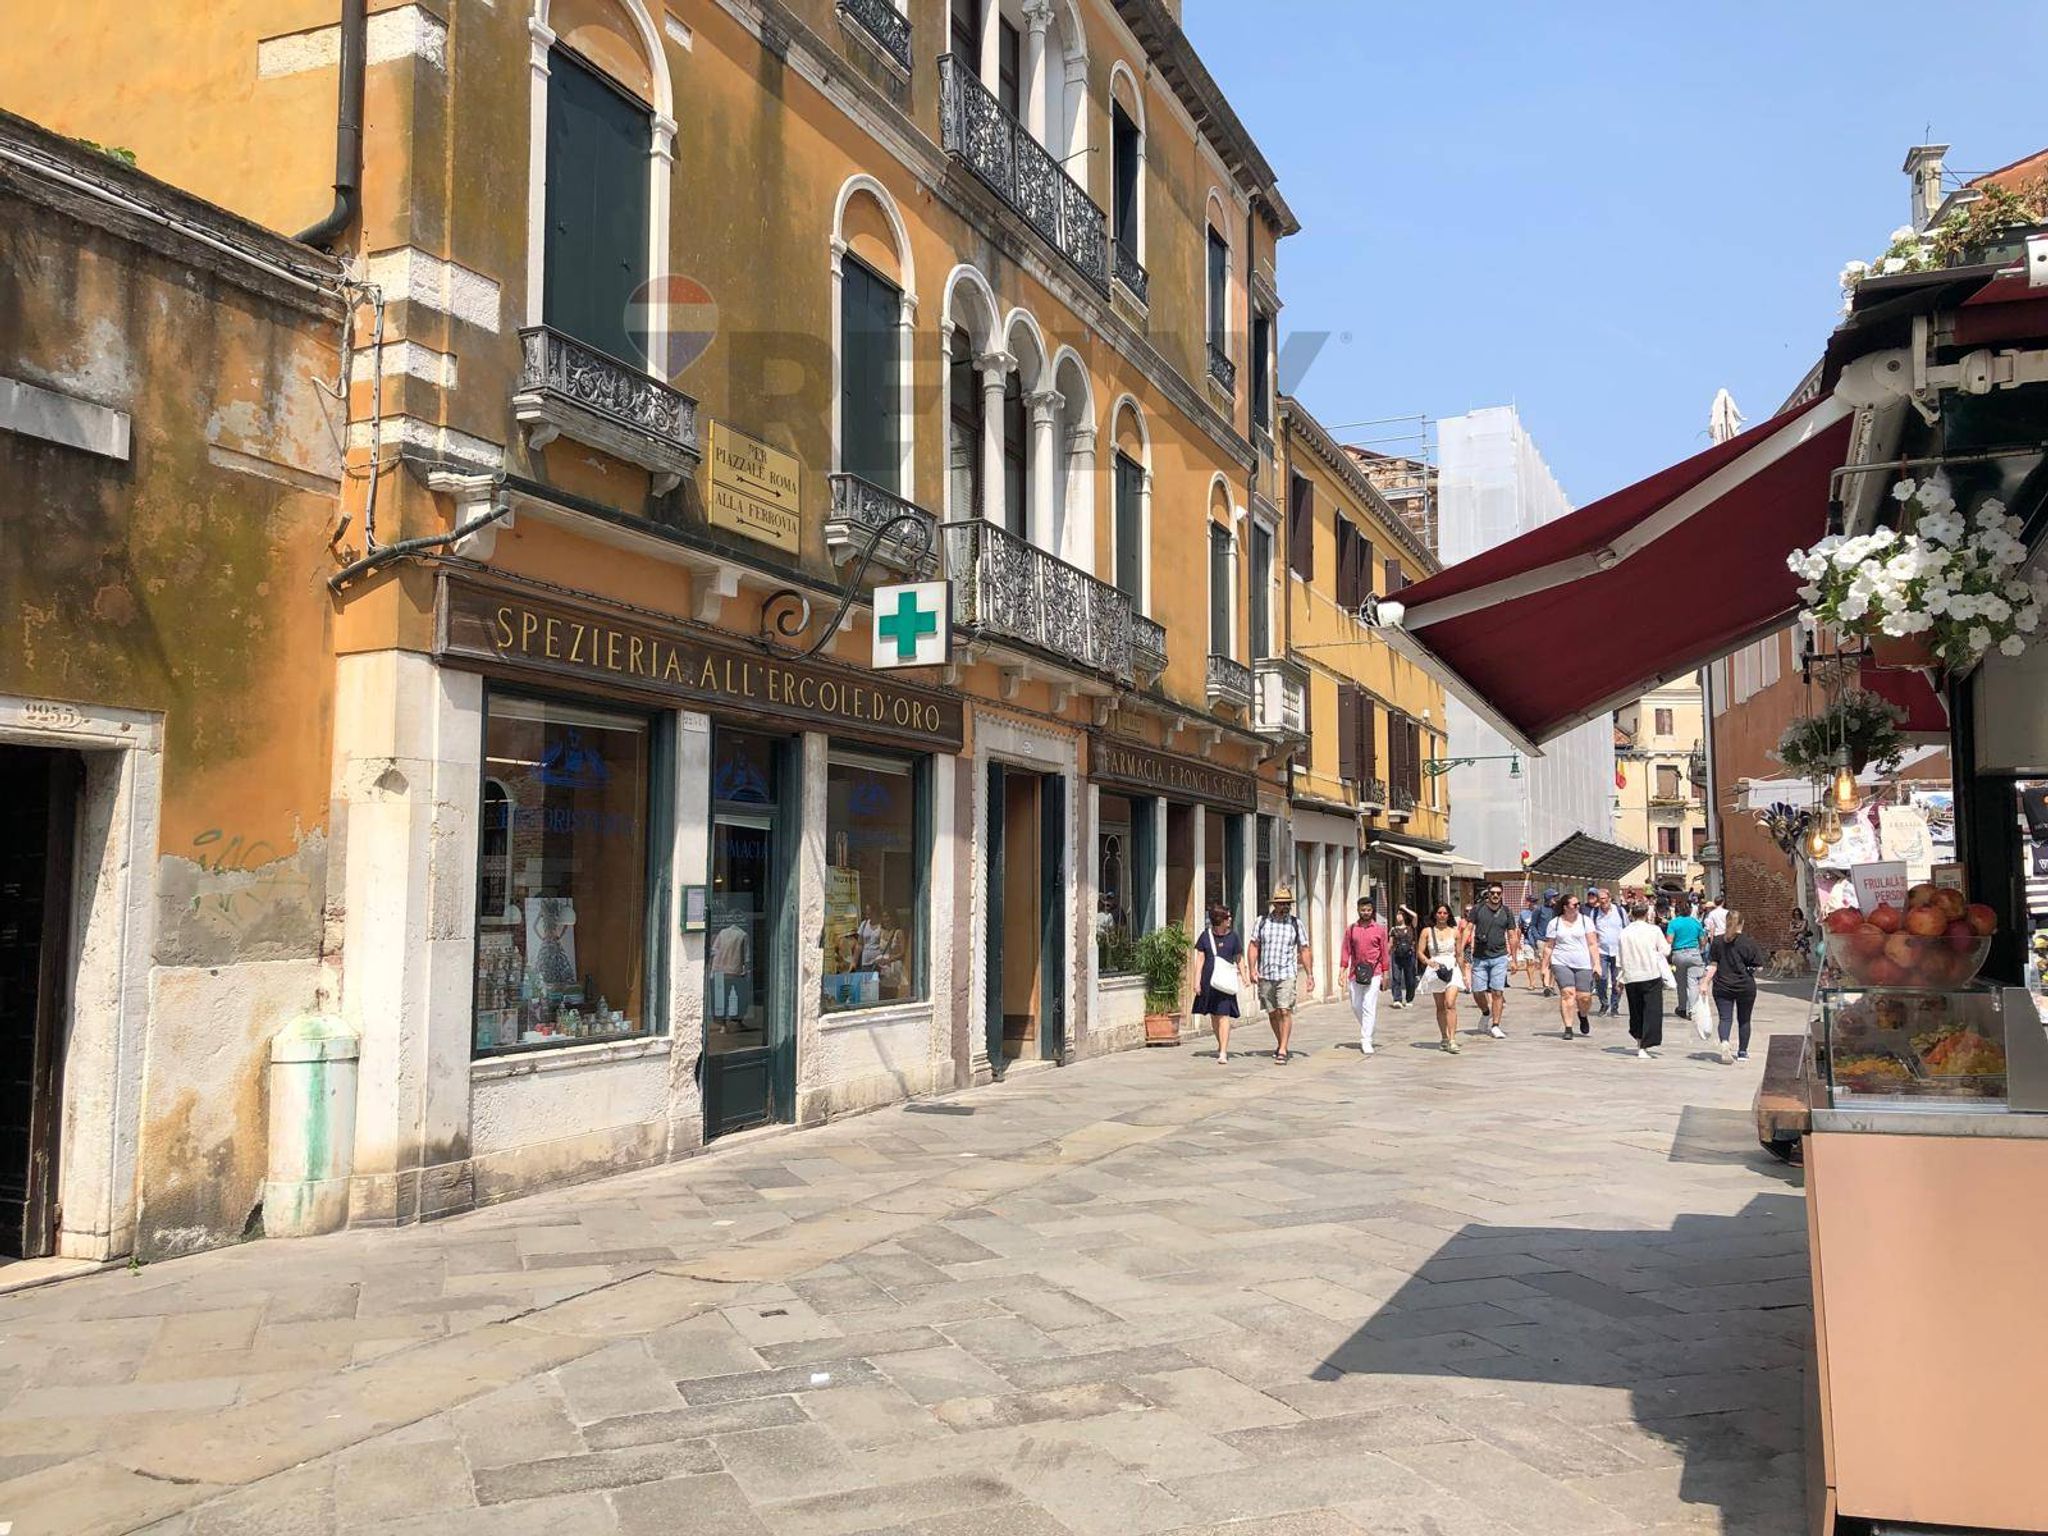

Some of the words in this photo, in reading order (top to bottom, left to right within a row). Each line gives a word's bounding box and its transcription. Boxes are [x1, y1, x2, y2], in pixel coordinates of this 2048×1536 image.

[715, 446, 766, 481] PIAZZALE
[769, 470, 797, 495] ROMA
[748, 443, 768, 464] PER
[715, 492, 743, 513] ALLA
[748, 503, 798, 534] FERROVIA
[872, 691, 941, 732] D'ORO
[1103, 750, 1164, 784] FARMACIA
